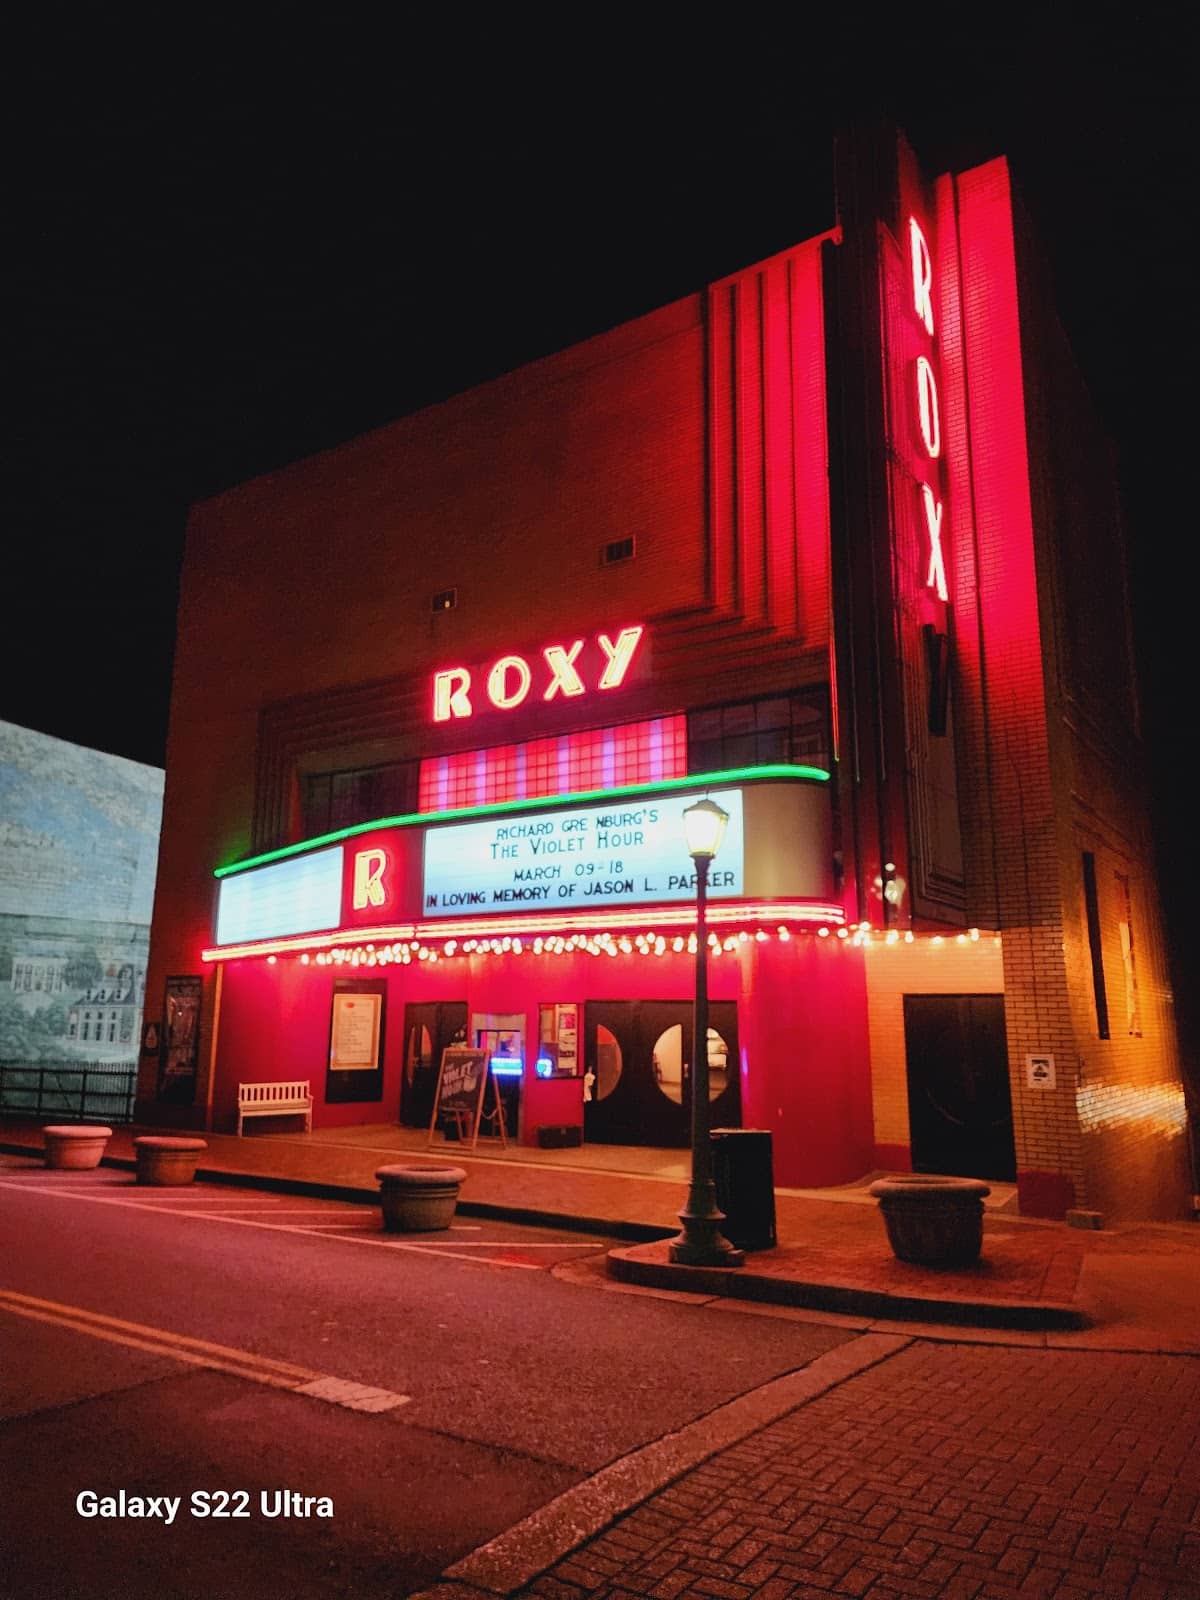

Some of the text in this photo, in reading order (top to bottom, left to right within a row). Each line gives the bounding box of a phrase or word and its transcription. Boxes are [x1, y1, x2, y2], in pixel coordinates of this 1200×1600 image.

[433, 626, 643, 722] ROXY
[496, 822, 553, 841] RICHARD
[352, 848, 387, 910] R
[426, 871, 735, 908] IN LOVING MEMORY OF JASON L. PARER
[513, 865, 561, 882] MARCH
